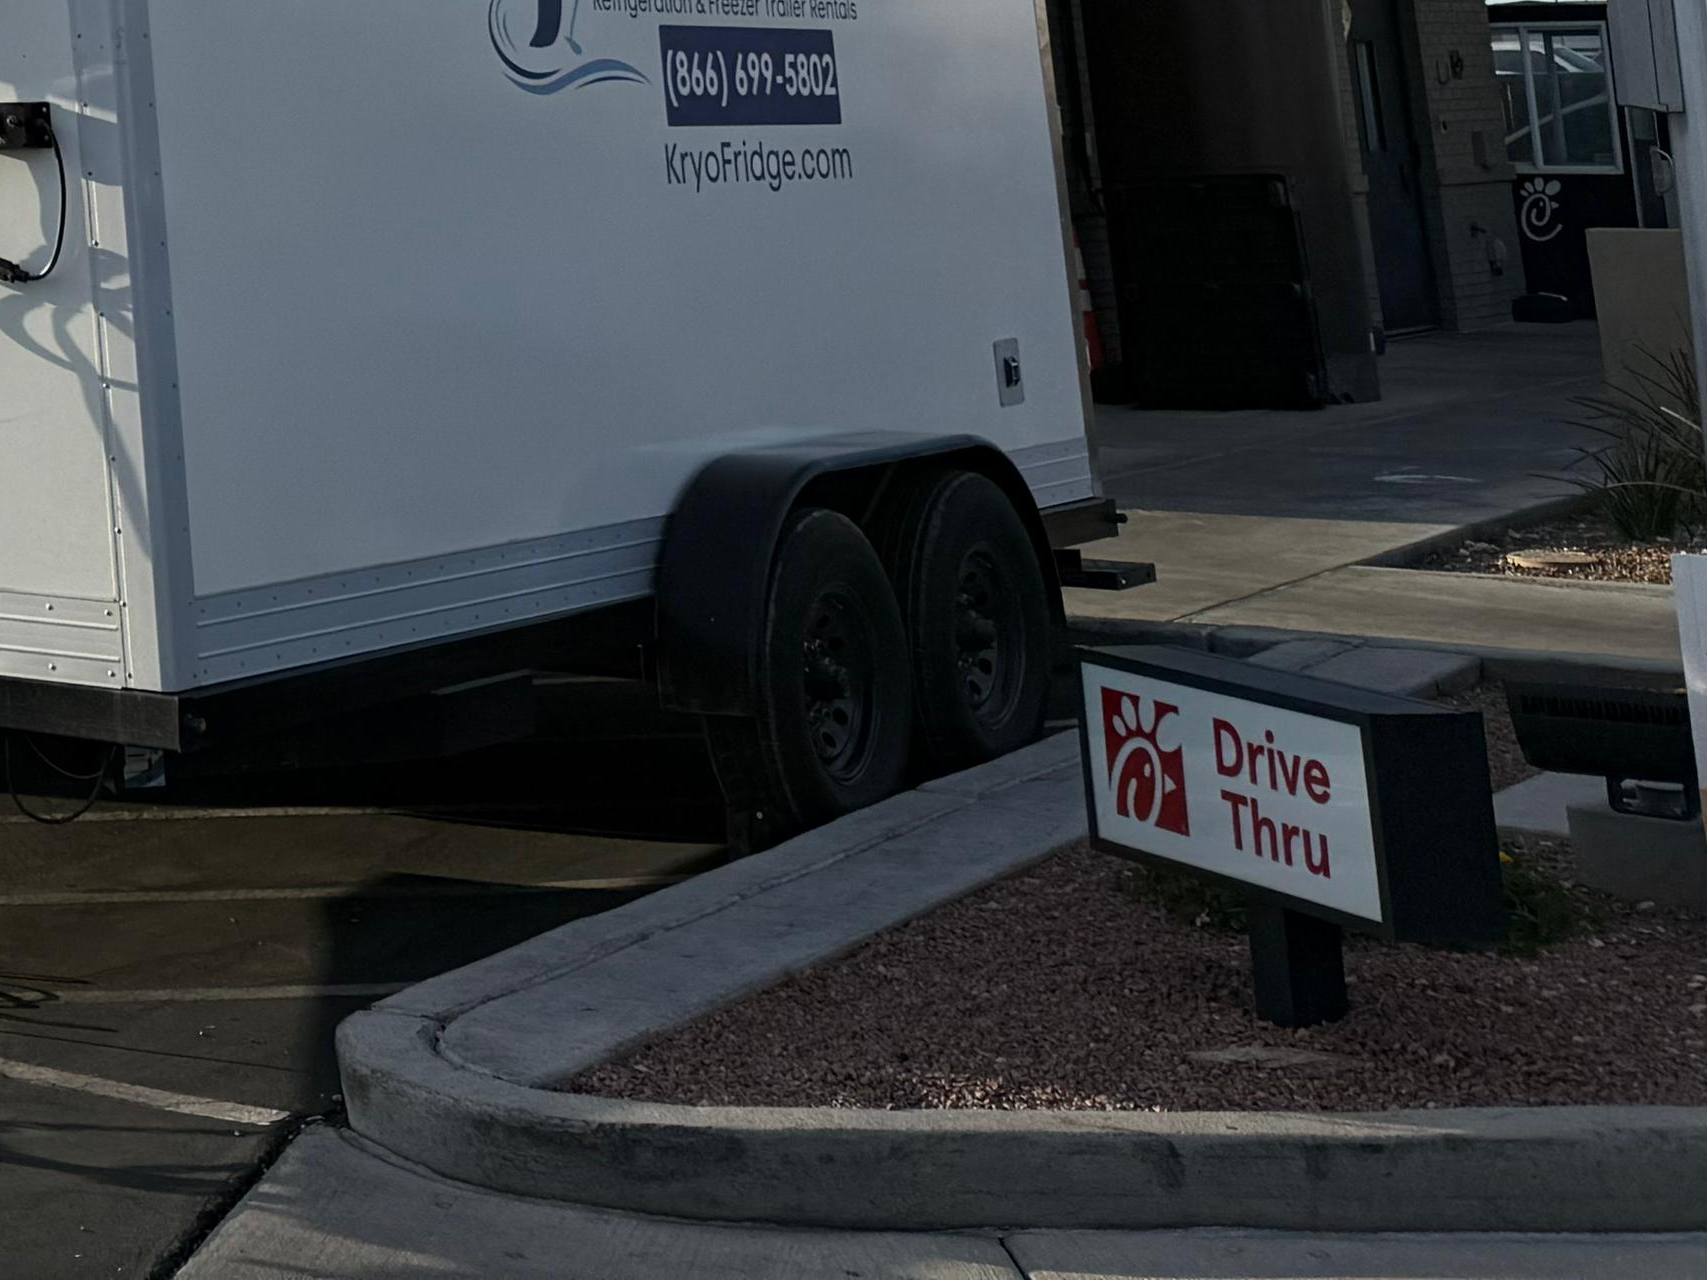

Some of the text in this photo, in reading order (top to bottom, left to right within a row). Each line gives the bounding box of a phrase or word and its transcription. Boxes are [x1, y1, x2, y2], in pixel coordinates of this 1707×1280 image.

[666, 49, 837, 108] (866) 699-5802
[664, 139, 853, 193] KryoFridge.com
[1212, 717, 1331, 805] Drive
[1220, 789, 1331, 880] Thru
